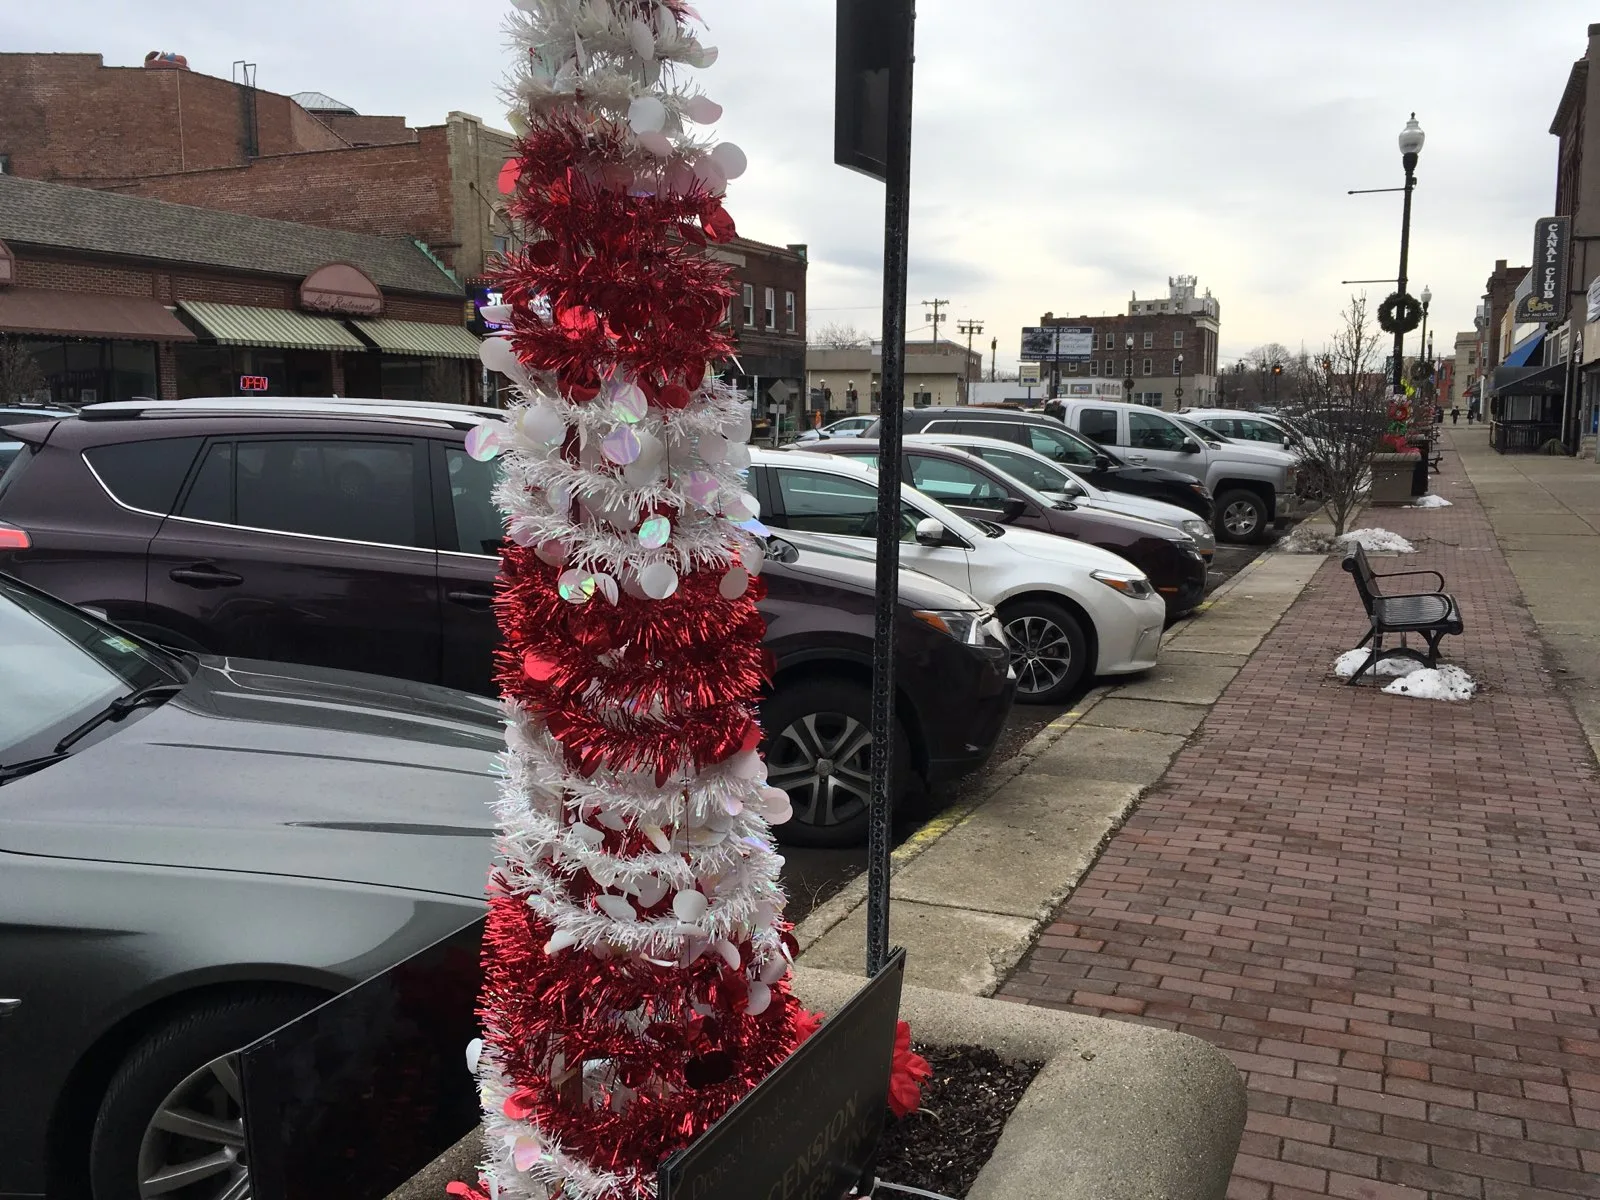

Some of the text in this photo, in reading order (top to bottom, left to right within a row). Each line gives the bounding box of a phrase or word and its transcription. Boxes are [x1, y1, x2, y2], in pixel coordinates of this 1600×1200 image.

[1543, 223, 1559, 299] CANAL CLUB
[242, 376, 267, 390] OPEN
